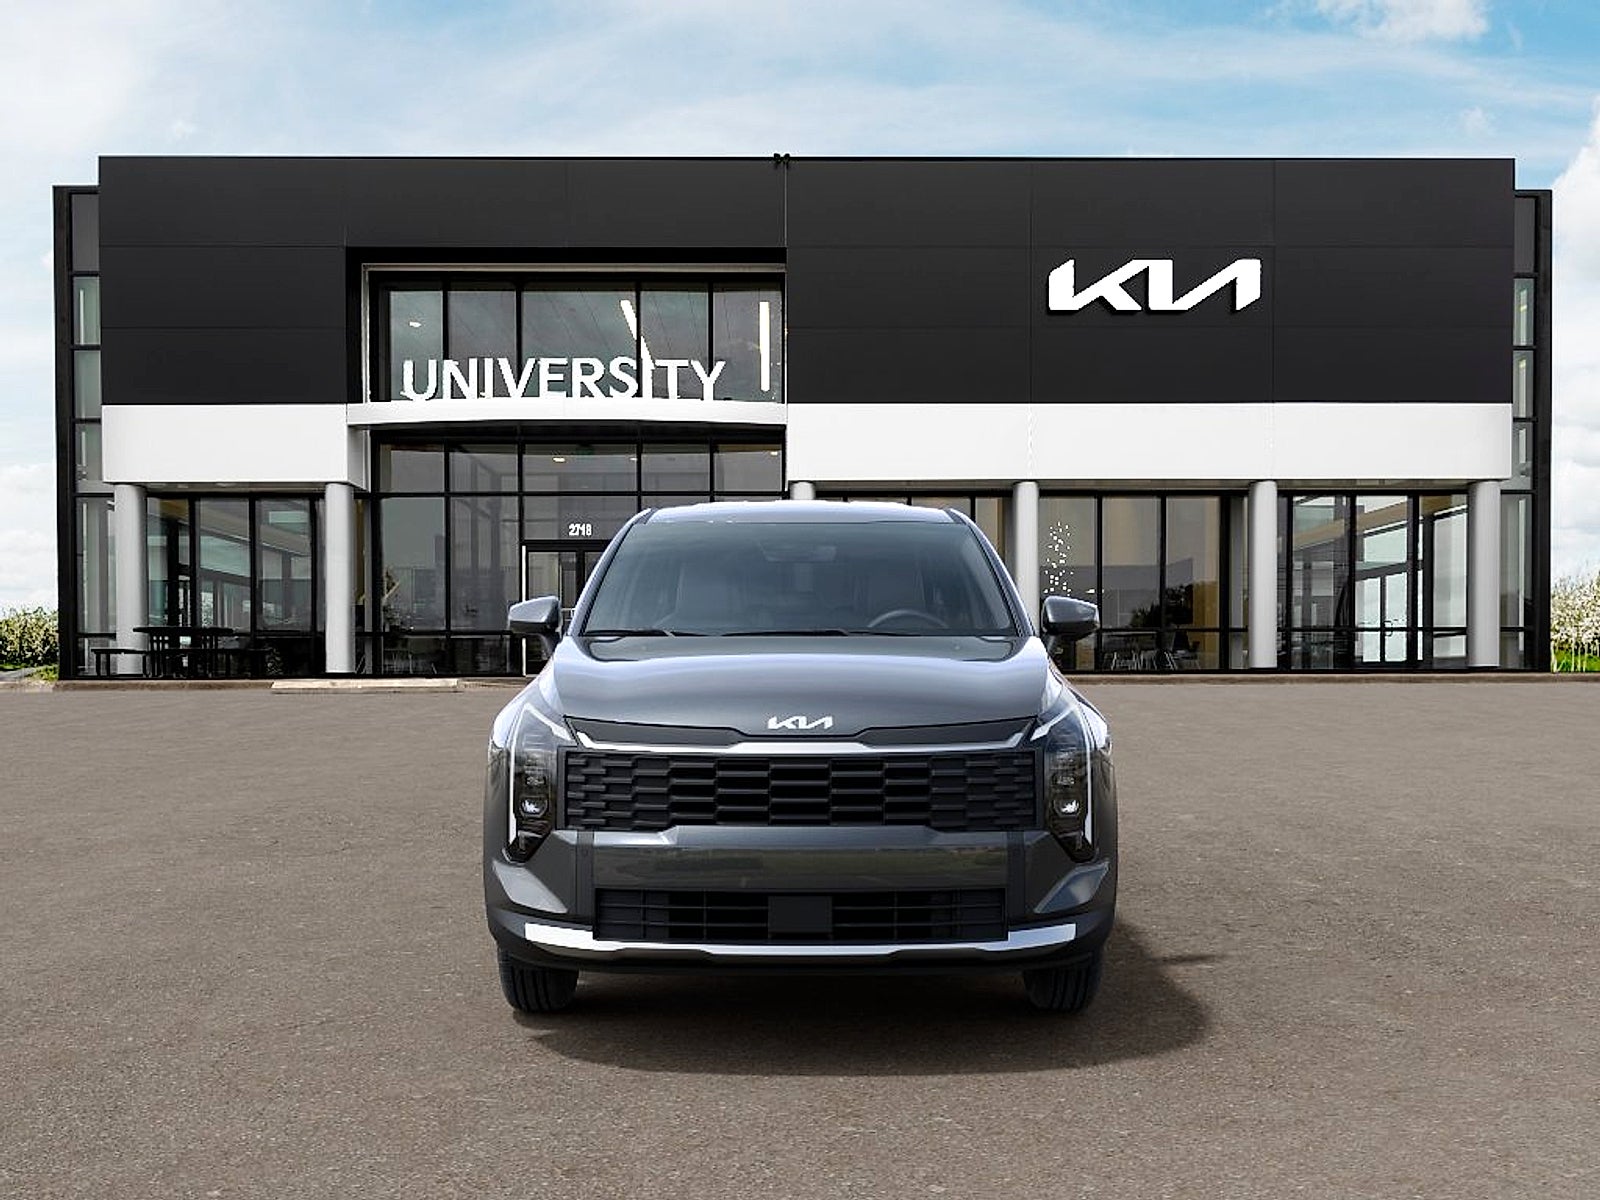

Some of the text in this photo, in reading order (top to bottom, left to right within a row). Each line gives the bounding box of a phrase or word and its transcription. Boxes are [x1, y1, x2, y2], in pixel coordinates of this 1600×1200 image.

[1048, 258, 1262, 312] KIA
[402, 357, 726, 401] UNIVERSITY
[568, 523, 592, 537] 2718
[767, 715, 833, 730] KIA
